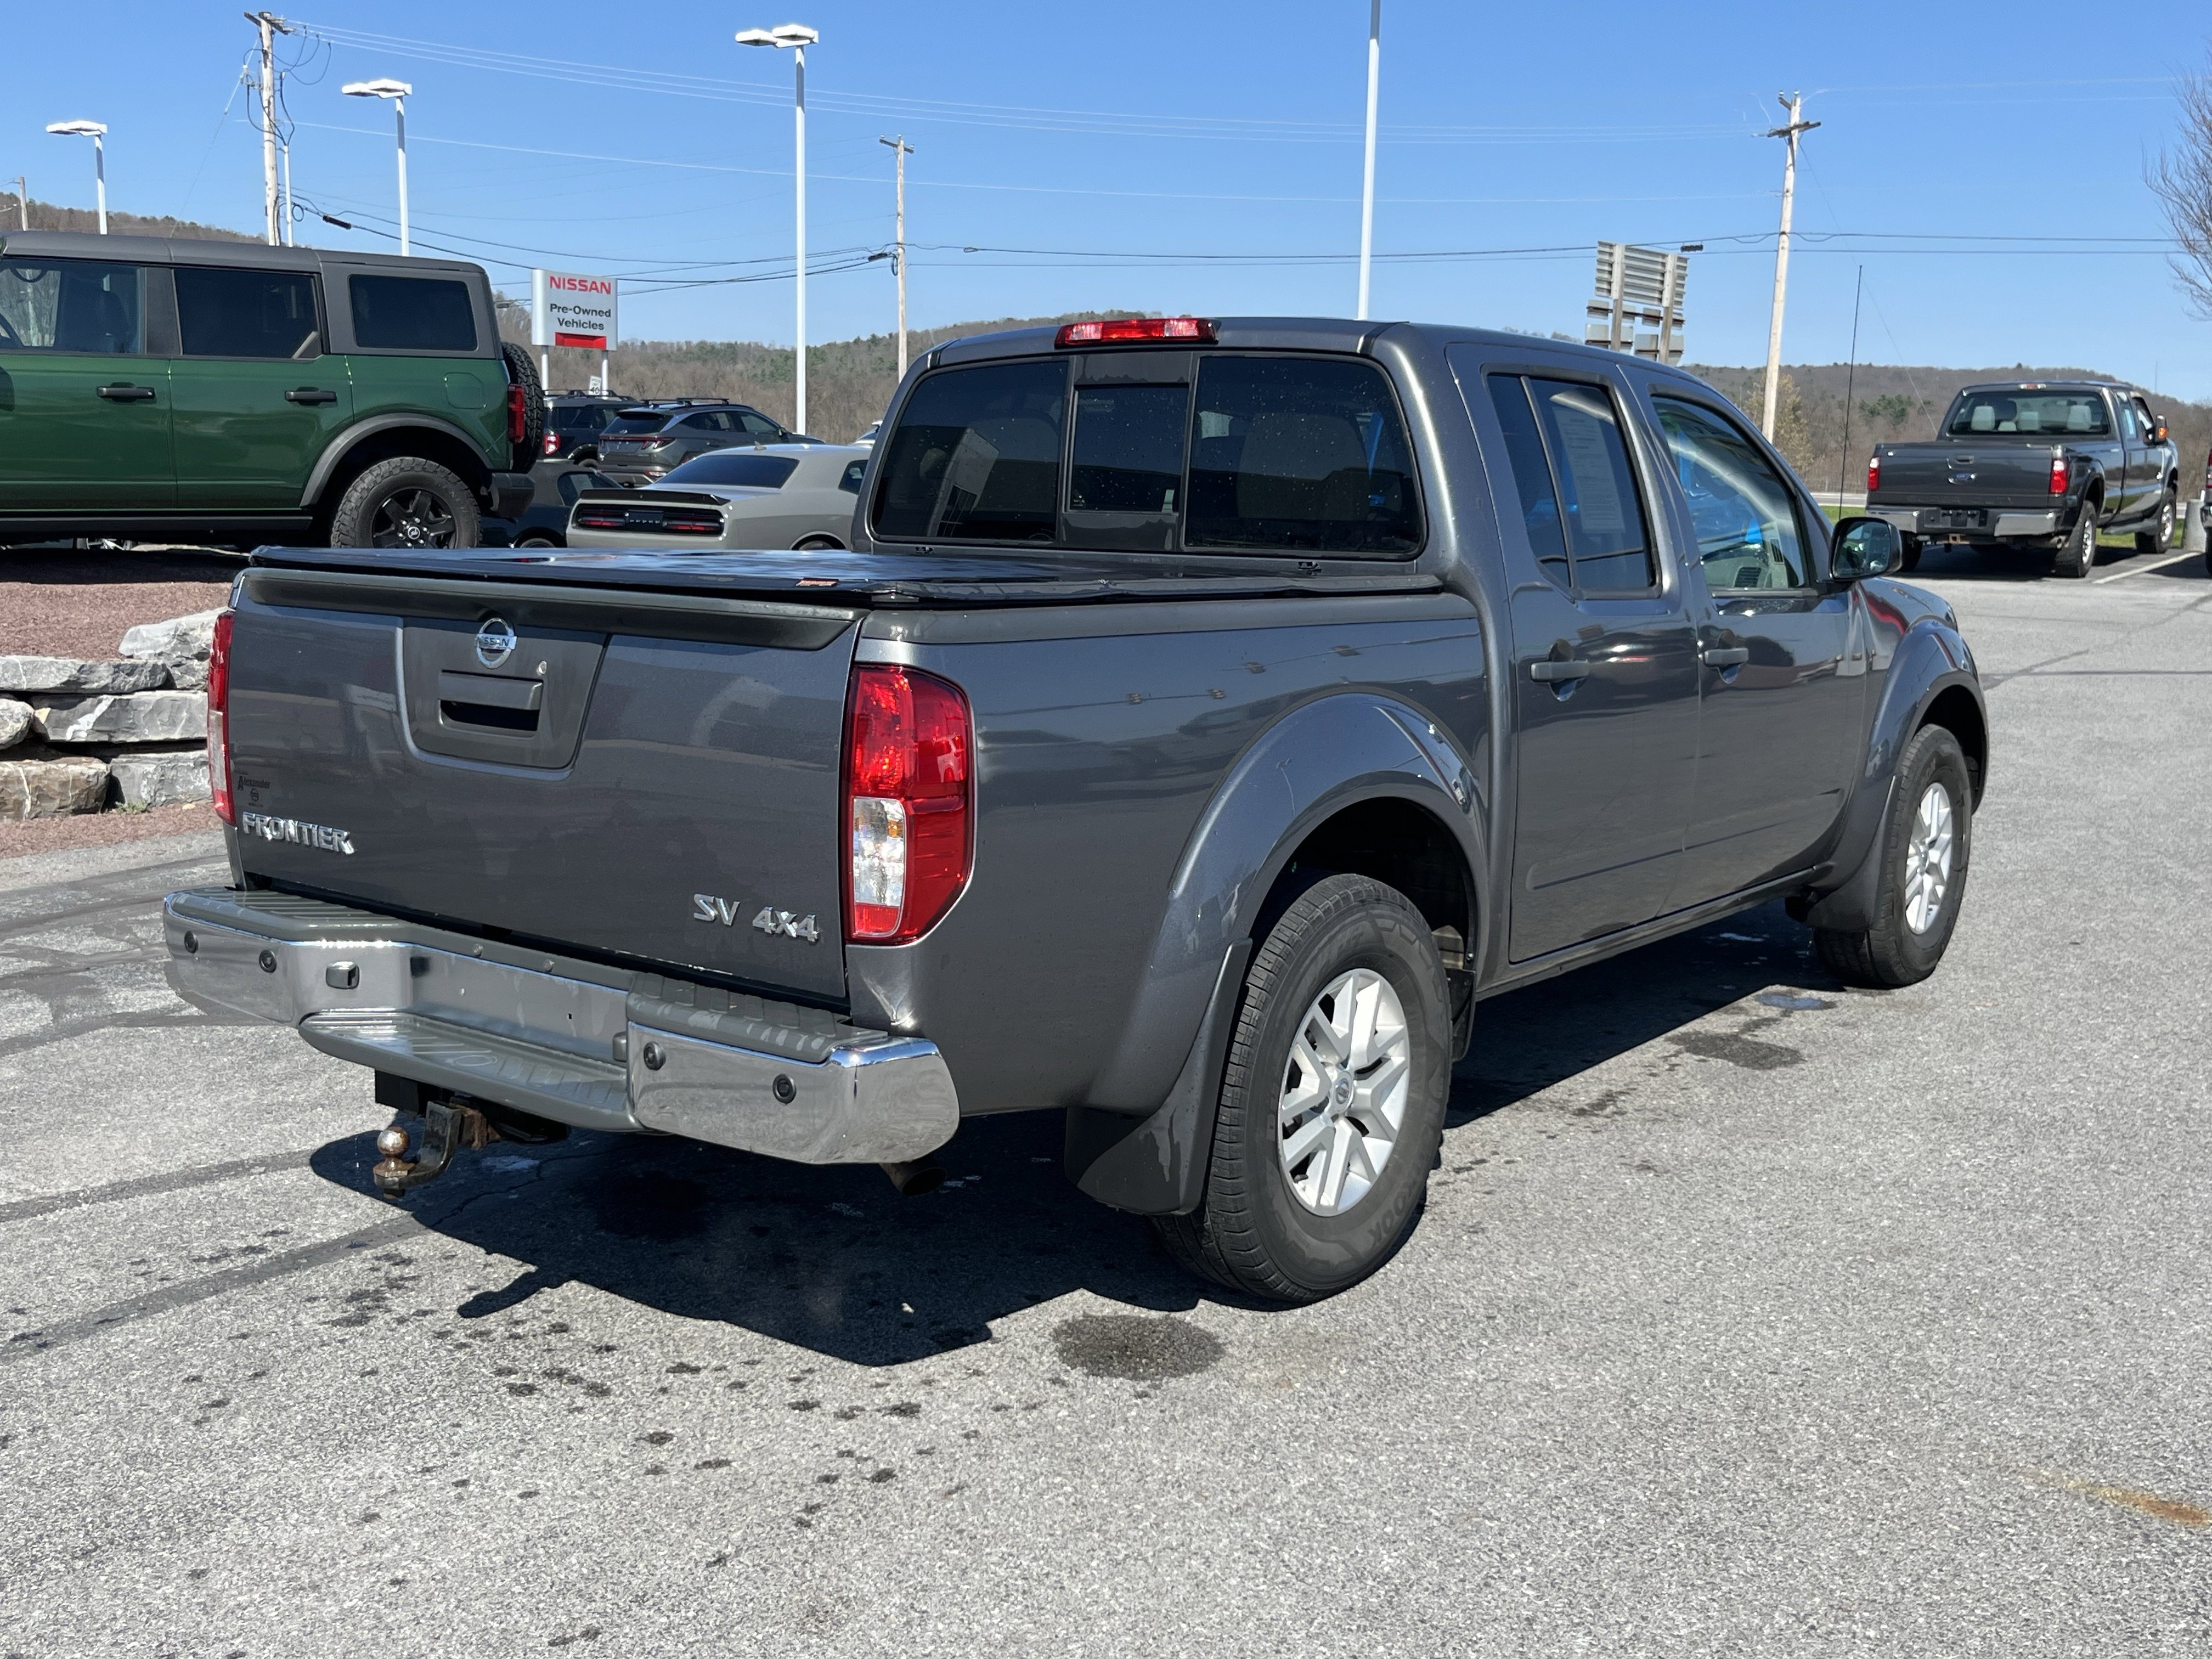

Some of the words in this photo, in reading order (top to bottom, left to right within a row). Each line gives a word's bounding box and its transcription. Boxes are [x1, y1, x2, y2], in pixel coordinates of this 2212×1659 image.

[550, 276, 611, 295] NISSAN
[550, 303, 611, 318] Pre-Owned
[557, 318, 605, 330] Vehicles
[242, 811, 355, 855] FRONTIER
[694, 894, 741, 926] SV
